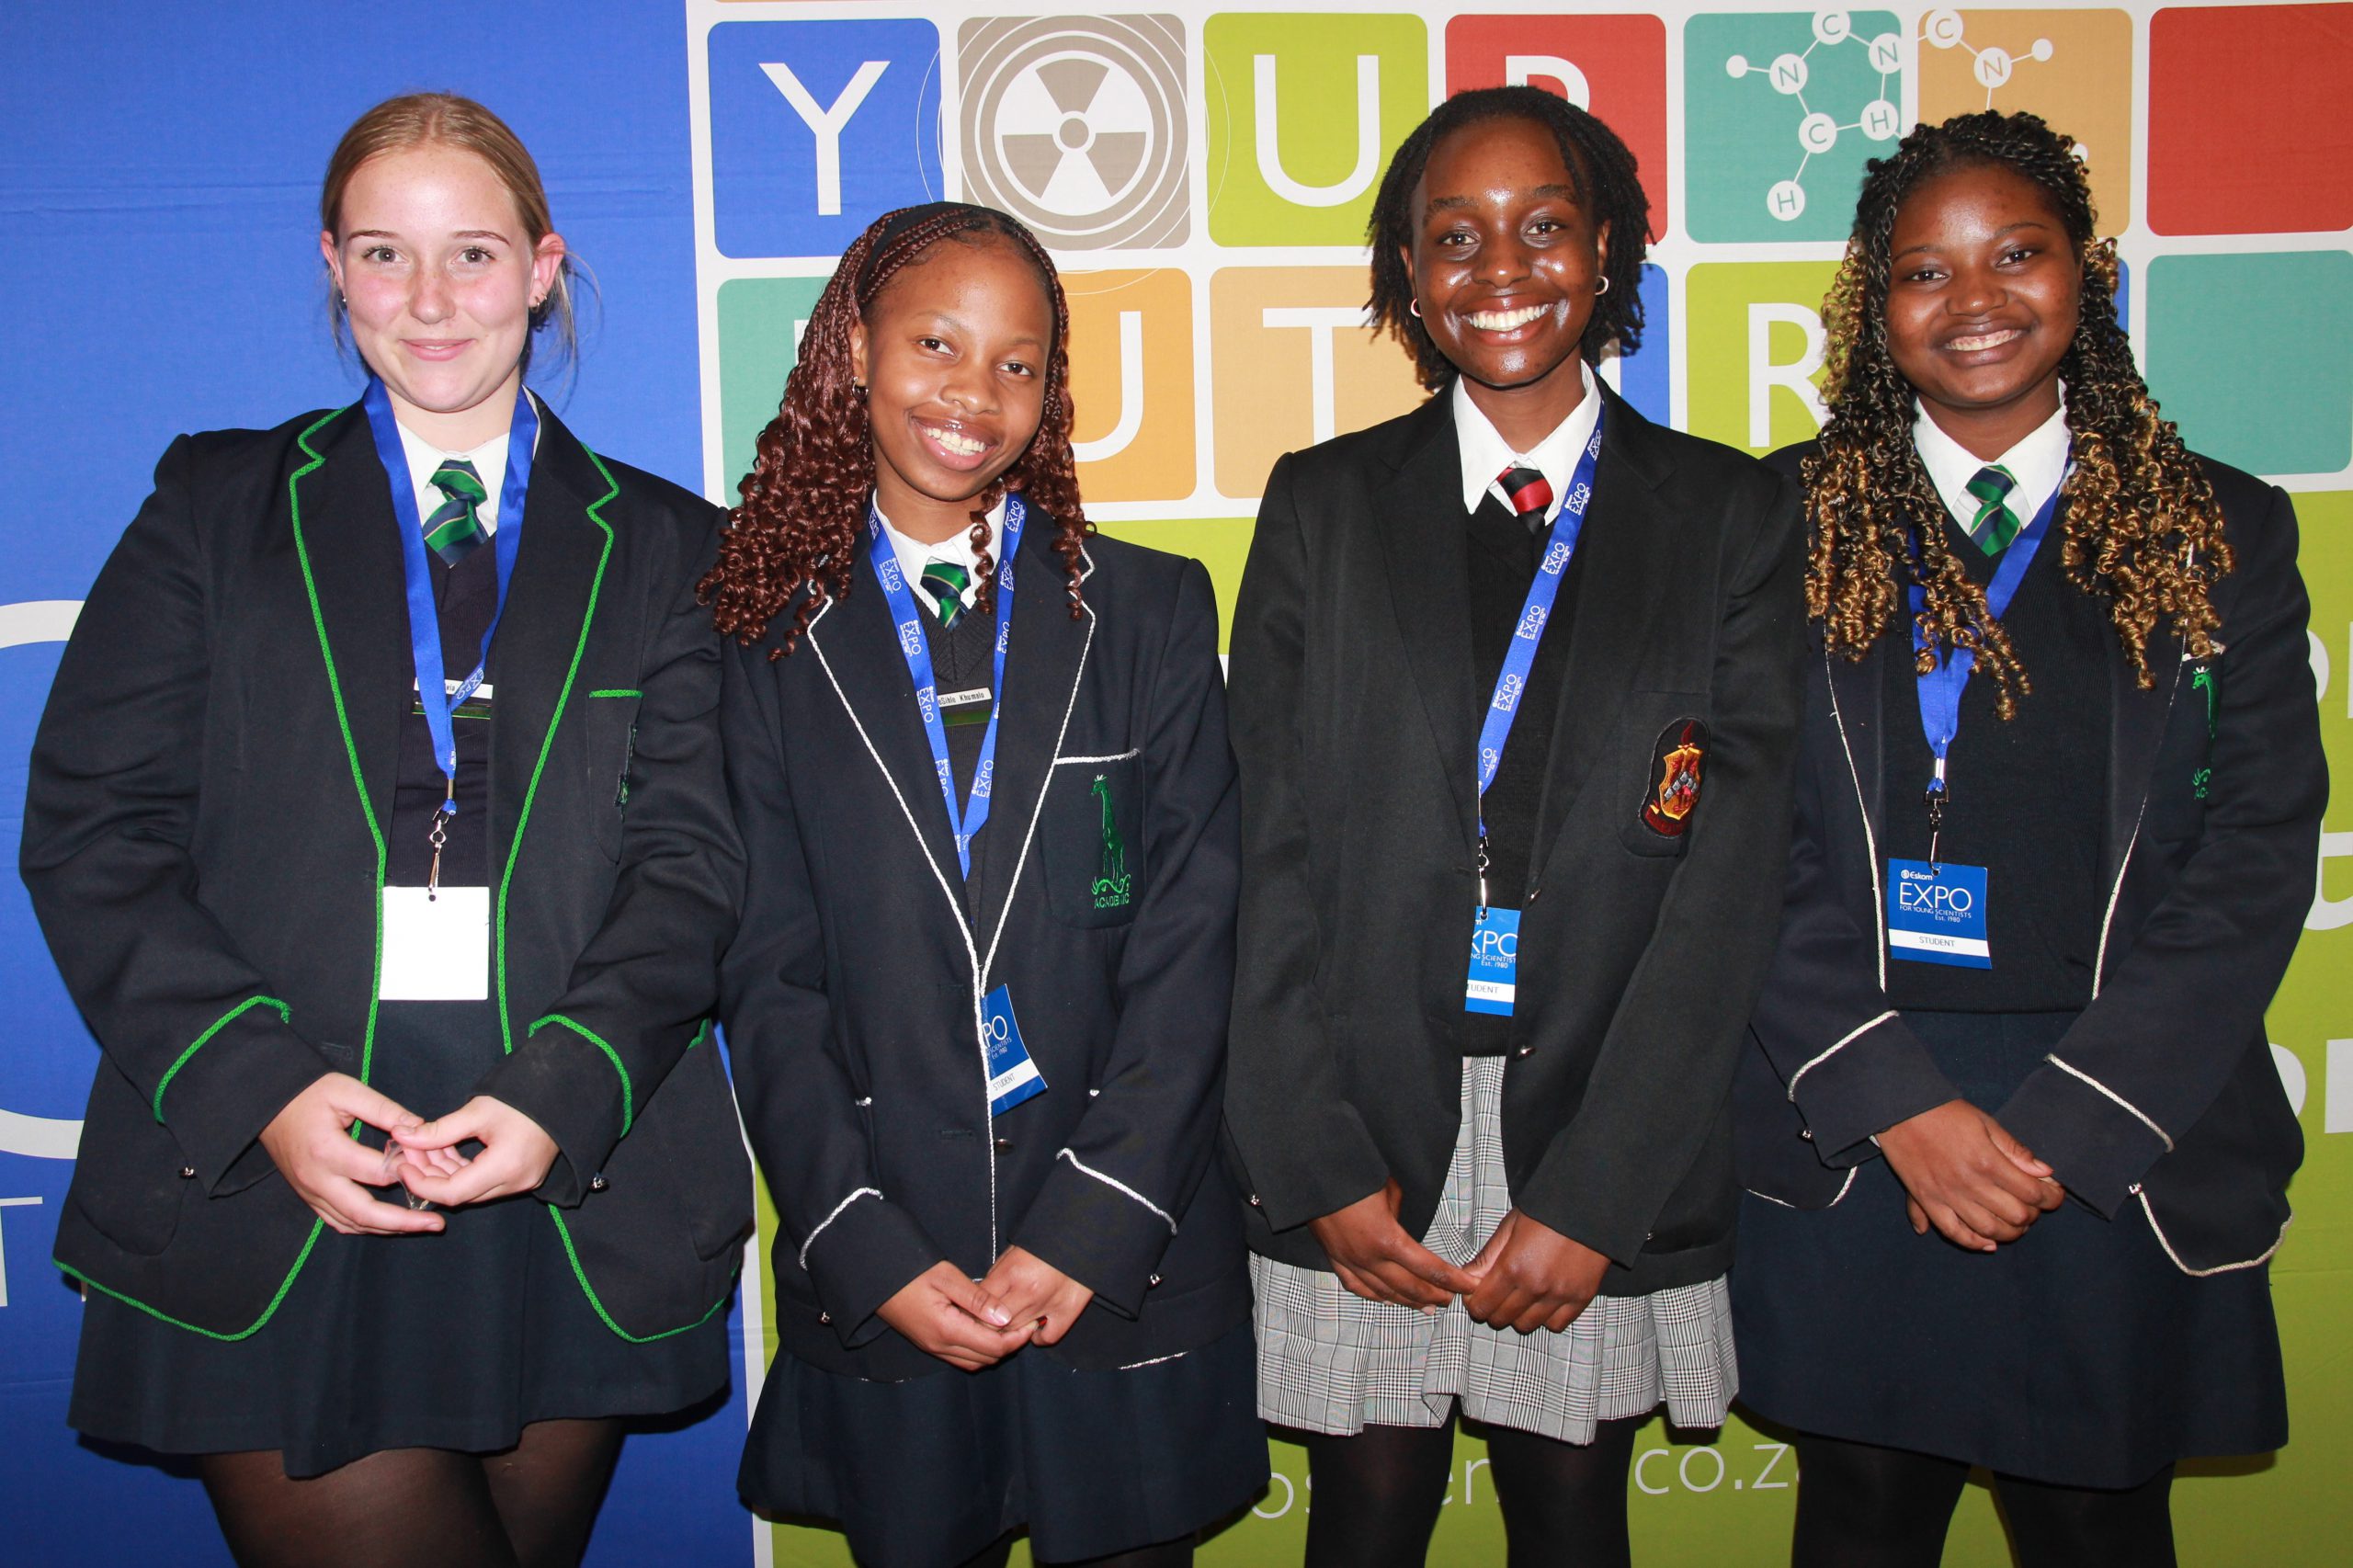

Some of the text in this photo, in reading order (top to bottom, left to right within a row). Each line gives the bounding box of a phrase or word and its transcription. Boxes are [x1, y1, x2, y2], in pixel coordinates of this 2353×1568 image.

[1821, 14, 1842, 36] C
[1935, 17, 1955, 40] C
[1877, 41, 1899, 67] N
[1778, 62, 1801, 87] N
[1983, 56, 2004, 81] N
[1808, 121, 1828, 144] C
[1870, 108, 1890, 133] H
[1776, 189, 1796, 213] H
[1569, 483, 1586, 515] EXPO
[1006, 500, 1020, 532] EXPO
[1544, 541, 1565, 575] EXPO
[882, 559, 902, 592] EXPO
[1520, 605, 1541, 639] EXPO
[903, 621, 922, 655] EXPO
[456, 667, 484, 699] EXPO
[1496, 674, 1518, 711] EXPO
[919, 687, 934, 723] EXPO
[976, 759, 994, 798] EXPO
[1909, 870, 1933, 881] Eskom
[1899, 881, 1972, 912] EXPO
[1913, 905, 1934, 915] YOUNG
[1935, 909, 1972, 918] SCIENTISTS
[1918, 936, 1956, 947] STUDENT
[1482, 954, 1517, 964] SCIENTIST
[1467, 983, 1500, 994] TUDENT
[993, 1073, 1016, 1091] STUDENT
